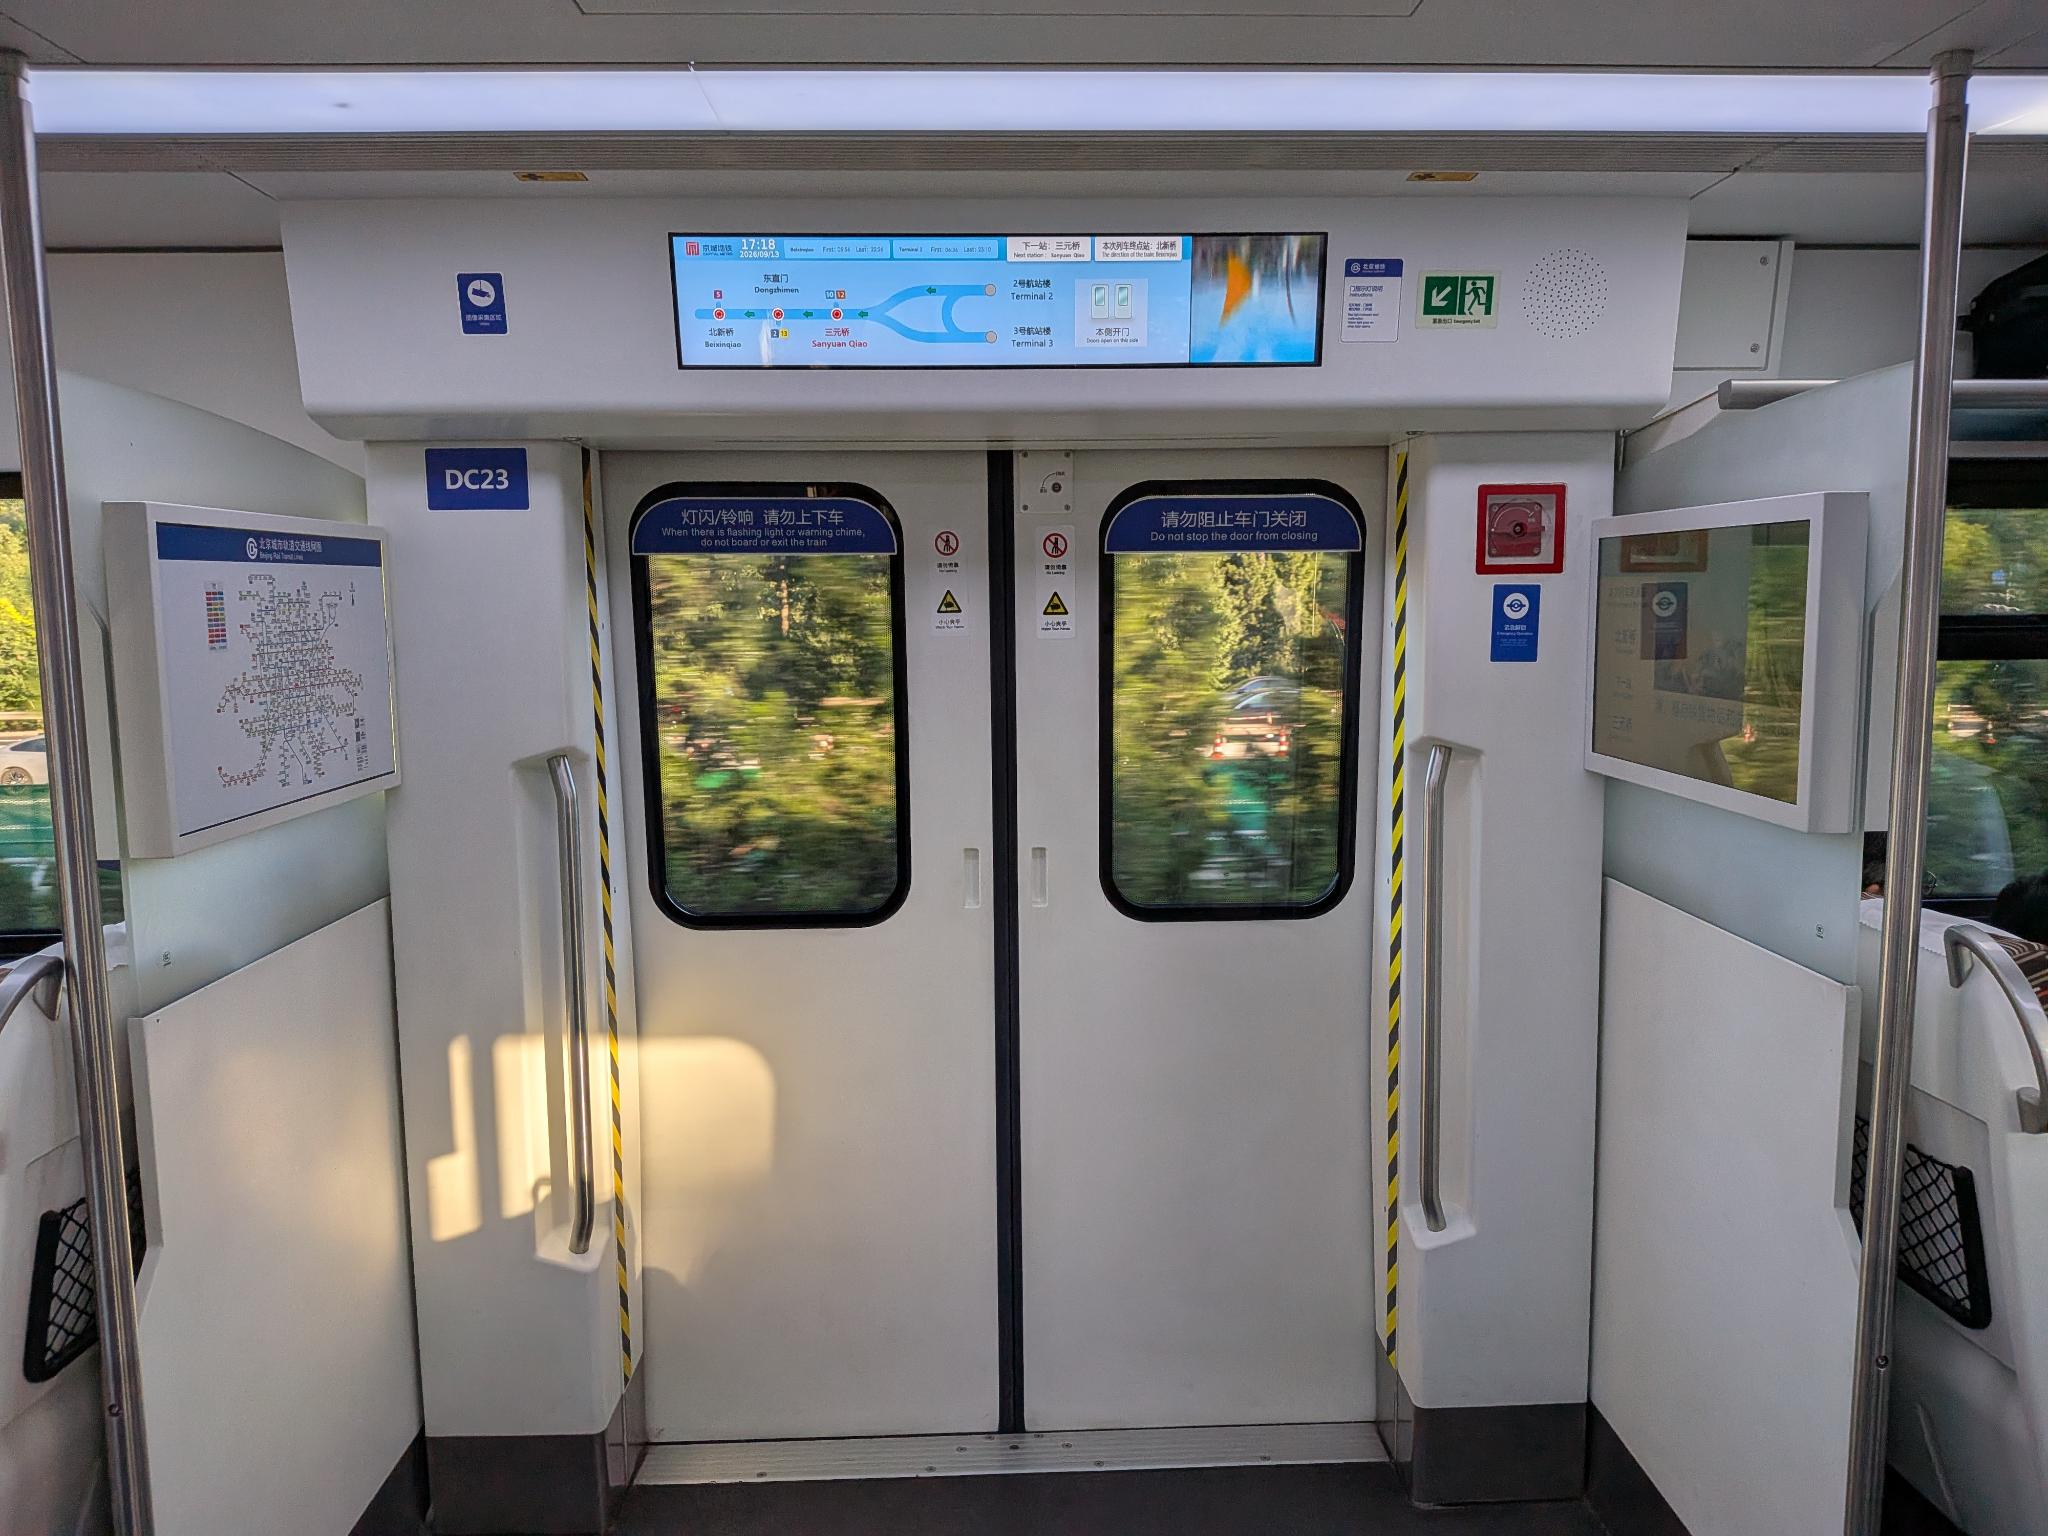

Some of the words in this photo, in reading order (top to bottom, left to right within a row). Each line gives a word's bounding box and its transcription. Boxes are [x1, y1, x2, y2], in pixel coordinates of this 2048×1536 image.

[741, 239, 776, 250] 17:18
[763, 274, 789, 283] 东直门
[1013, 279, 1051, 288] 2号航站楼
[754, 286, 800, 294] Dongzhimen
[1011, 292, 1046, 300] Terminal
[1048, 292, 1054, 300] 2
[708, 327, 734, 336] 北新桥
[824, 327, 850, 336] 三元桥
[1013, 326, 1052, 336] 3号航站楼
[1095, 327, 1130, 336] 本侧开门
[704, 341, 742, 349] Beixinqiao
[811, 340, 847, 350] Sanyuan
[848, 340, 868, 348] Qiao
[1012, 340, 1046, 348] Terminal
[1048, 340, 1054, 348] 3
[445, 468, 509, 490] DC23
[681, 508, 754, 526] 灯闪/铃响
[763, 508, 844, 526] 请勿上下车
[1160, 510, 1306, 528] 请勿阻止车门关闭
[662, 527, 689, 537] When
[691, 527, 715, 537] there
[717, 527, 725, 537] is
[726, 527, 762, 539] flashing
[764, 527, 784, 539] light
[786, 529, 796, 537] or
[798, 527, 834, 539] warning
[835, 527, 866, 538] chime,
[1150, 532, 1165, 541] Do
[1168, 532, 1184, 541] not
[1186, 532, 1208, 542] stop
[1211, 532, 1228, 541] the
[1230, 532, 1253, 541] door
[1256, 532, 1278, 541] from
[1280, 531, 1318, 542] closing
[700, 537, 712, 547] do
[713, 538, 730, 547] not
[732, 537, 758, 547] board
[760, 539, 770, 547] or
[772, 537, 788, 547] exit
[790, 537, 804, 547] the
[806, 537, 828, 547] train
